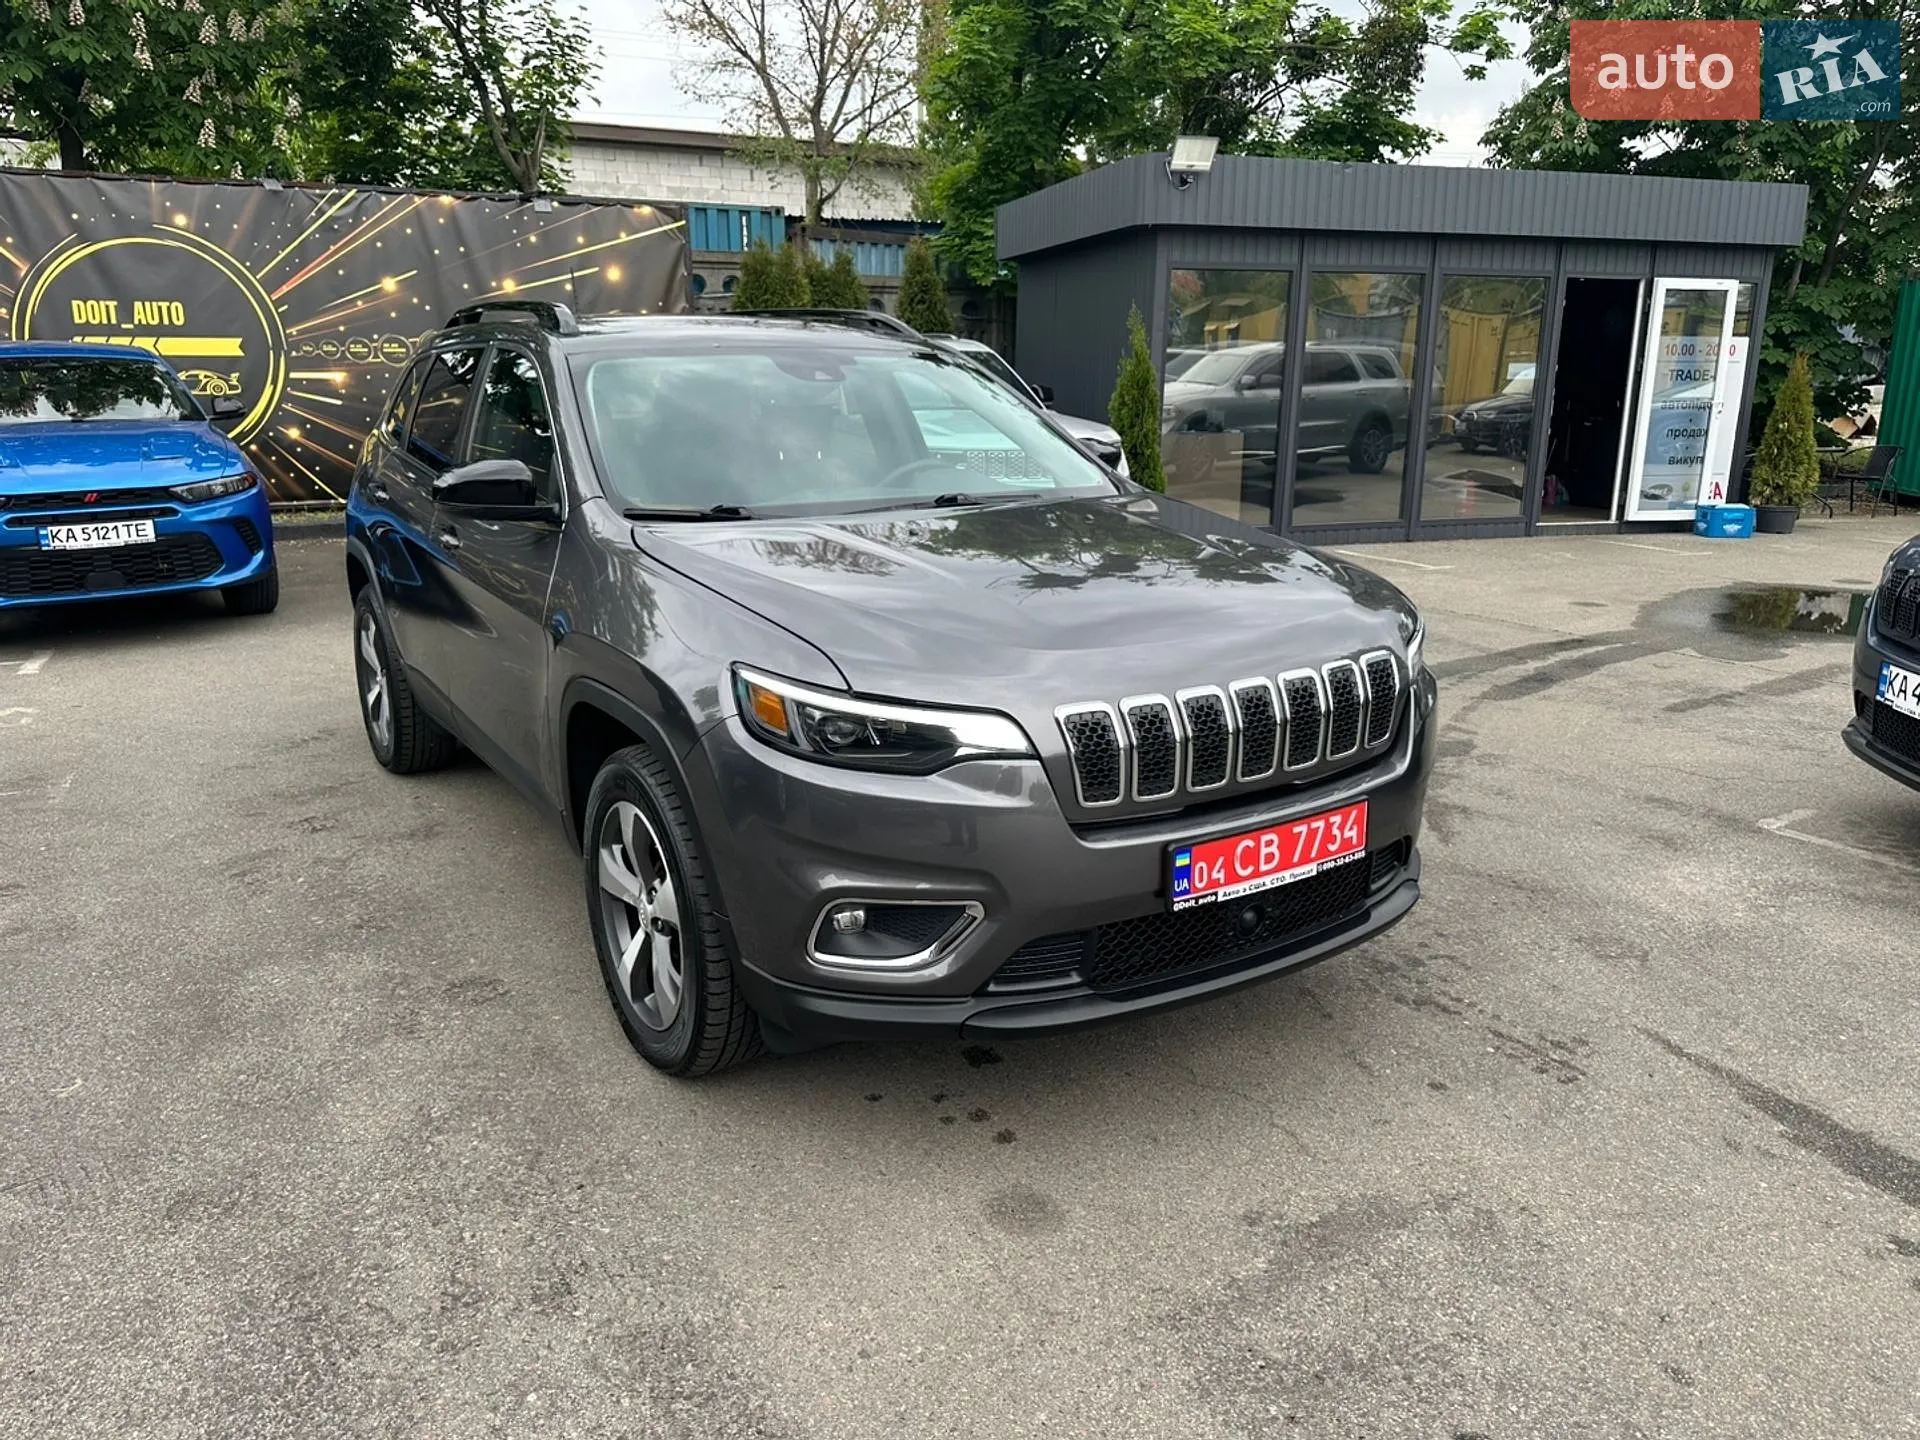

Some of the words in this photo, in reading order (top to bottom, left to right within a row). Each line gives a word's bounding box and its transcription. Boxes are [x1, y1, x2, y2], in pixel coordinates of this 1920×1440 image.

[1664, 343, 1695, 357] 10.00
[50, 527, 78, 544] KA
[81, 524, 120, 542] 5121
[122, 522, 149, 539] TE
[1886, 669, 1908, 701] KA
[1194, 856, 1226, 889] 04
[1233, 832, 1281, 877] CB
[1291, 809, 1358, 863] 7734
[1174, 878, 1190, 892] UA
